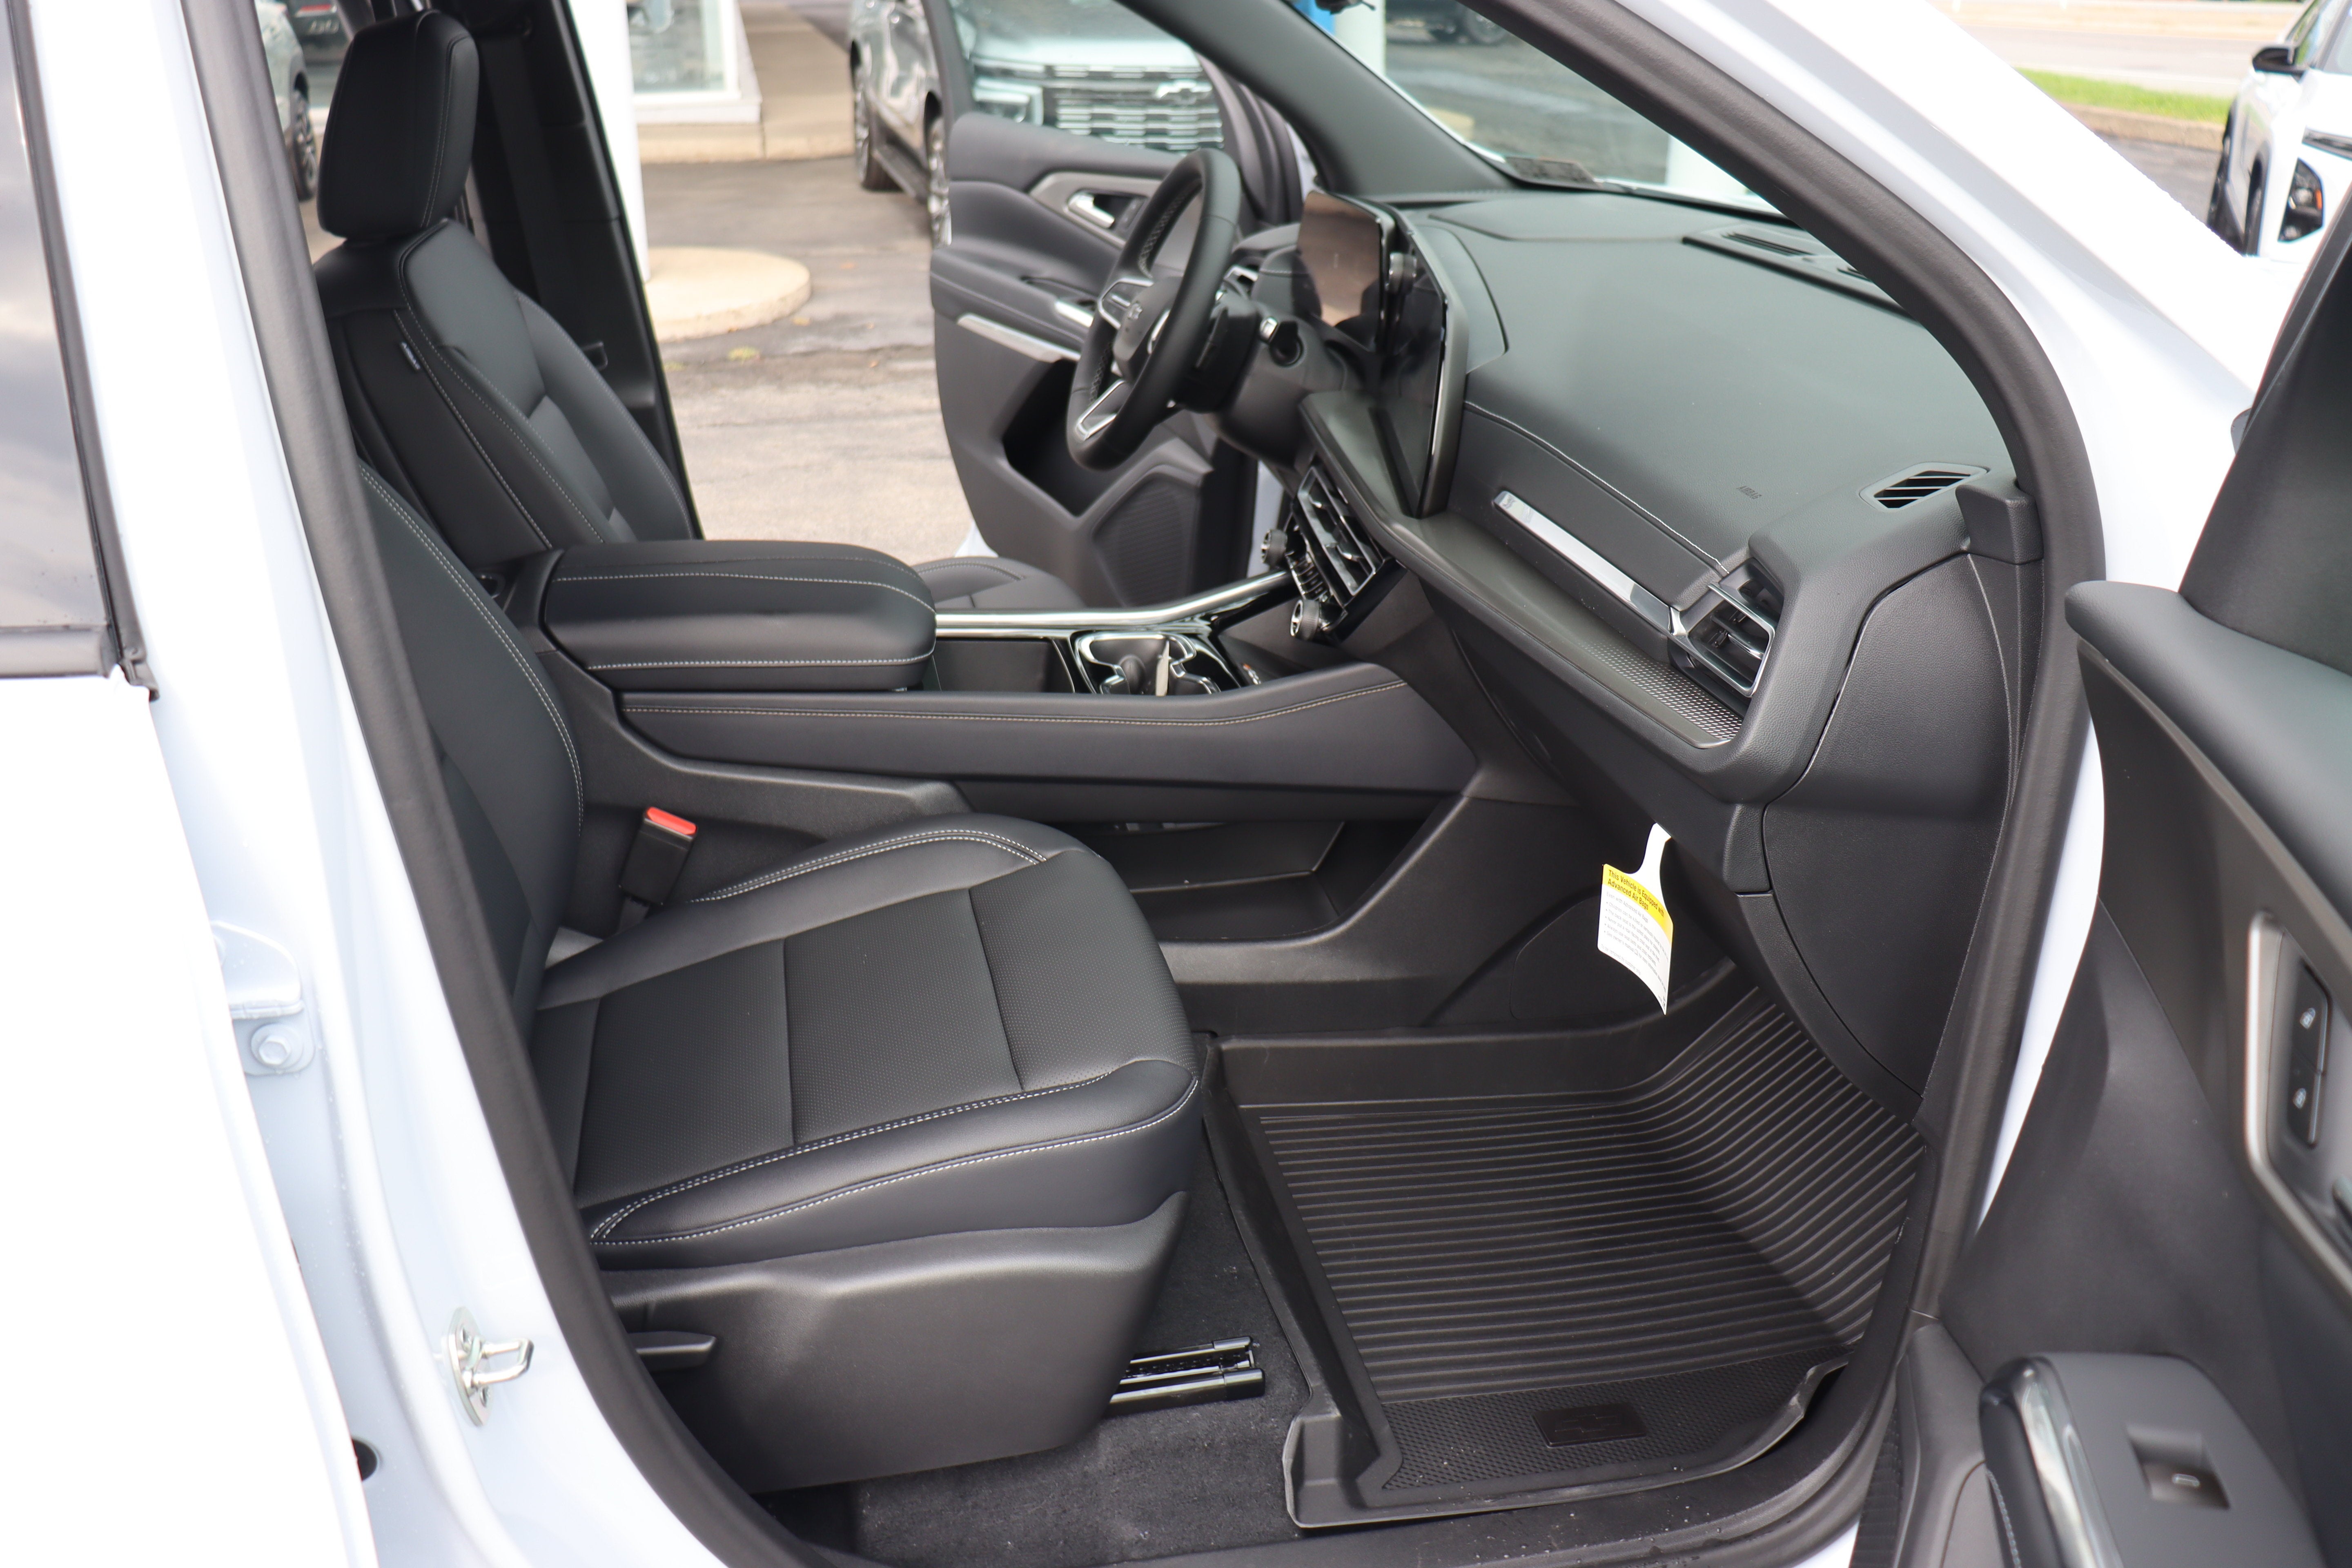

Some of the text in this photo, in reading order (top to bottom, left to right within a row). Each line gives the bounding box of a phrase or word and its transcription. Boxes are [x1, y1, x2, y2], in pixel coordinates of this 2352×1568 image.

[1736, 486, 1762, 499] AIRBAG
[1608, 879, 1631, 897] Advanced
[1639, 897, 1648, 910] Bags
[1609, 869, 1619, 880] This
[1621, 876, 1637, 891] Vehicle
[1642, 890, 1658, 909] Equipped
